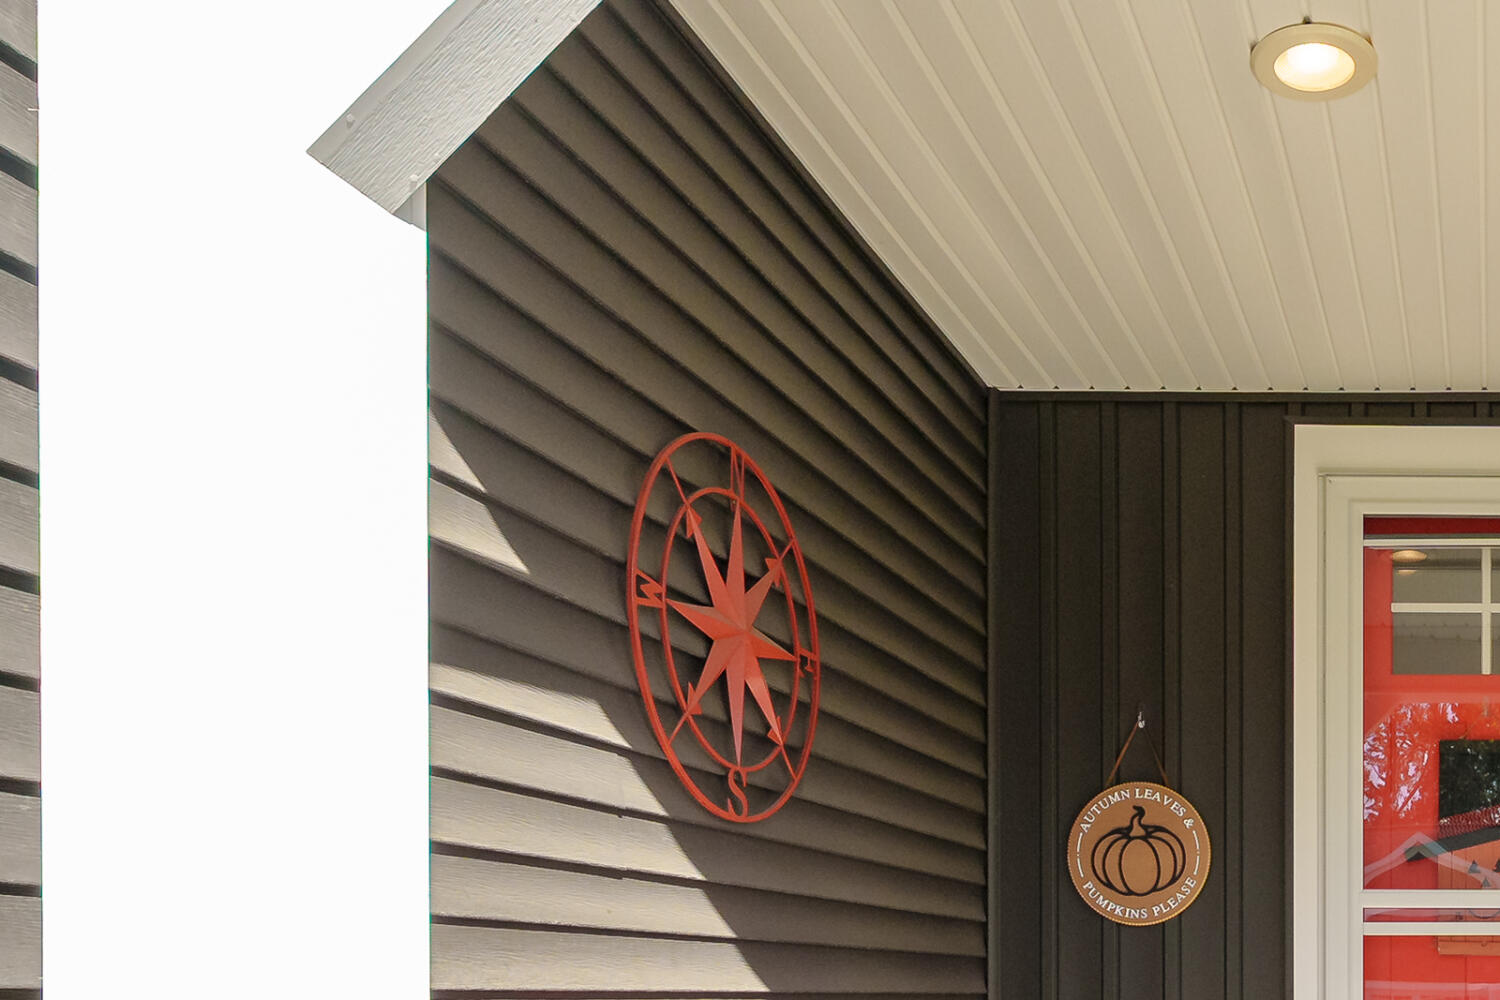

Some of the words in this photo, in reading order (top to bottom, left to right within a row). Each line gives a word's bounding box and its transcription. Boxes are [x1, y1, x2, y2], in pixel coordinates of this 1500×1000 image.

[727, 767, 749, 820] S
[1079, 788, 1131, 833] AUTUMN
[1134, 787, 1187, 818] LEAVES
[1183, 817, 1195, 829] &
[1082, 880, 1148, 919] PUMPKINS
[1151, 876, 1197, 917] PLEASE
